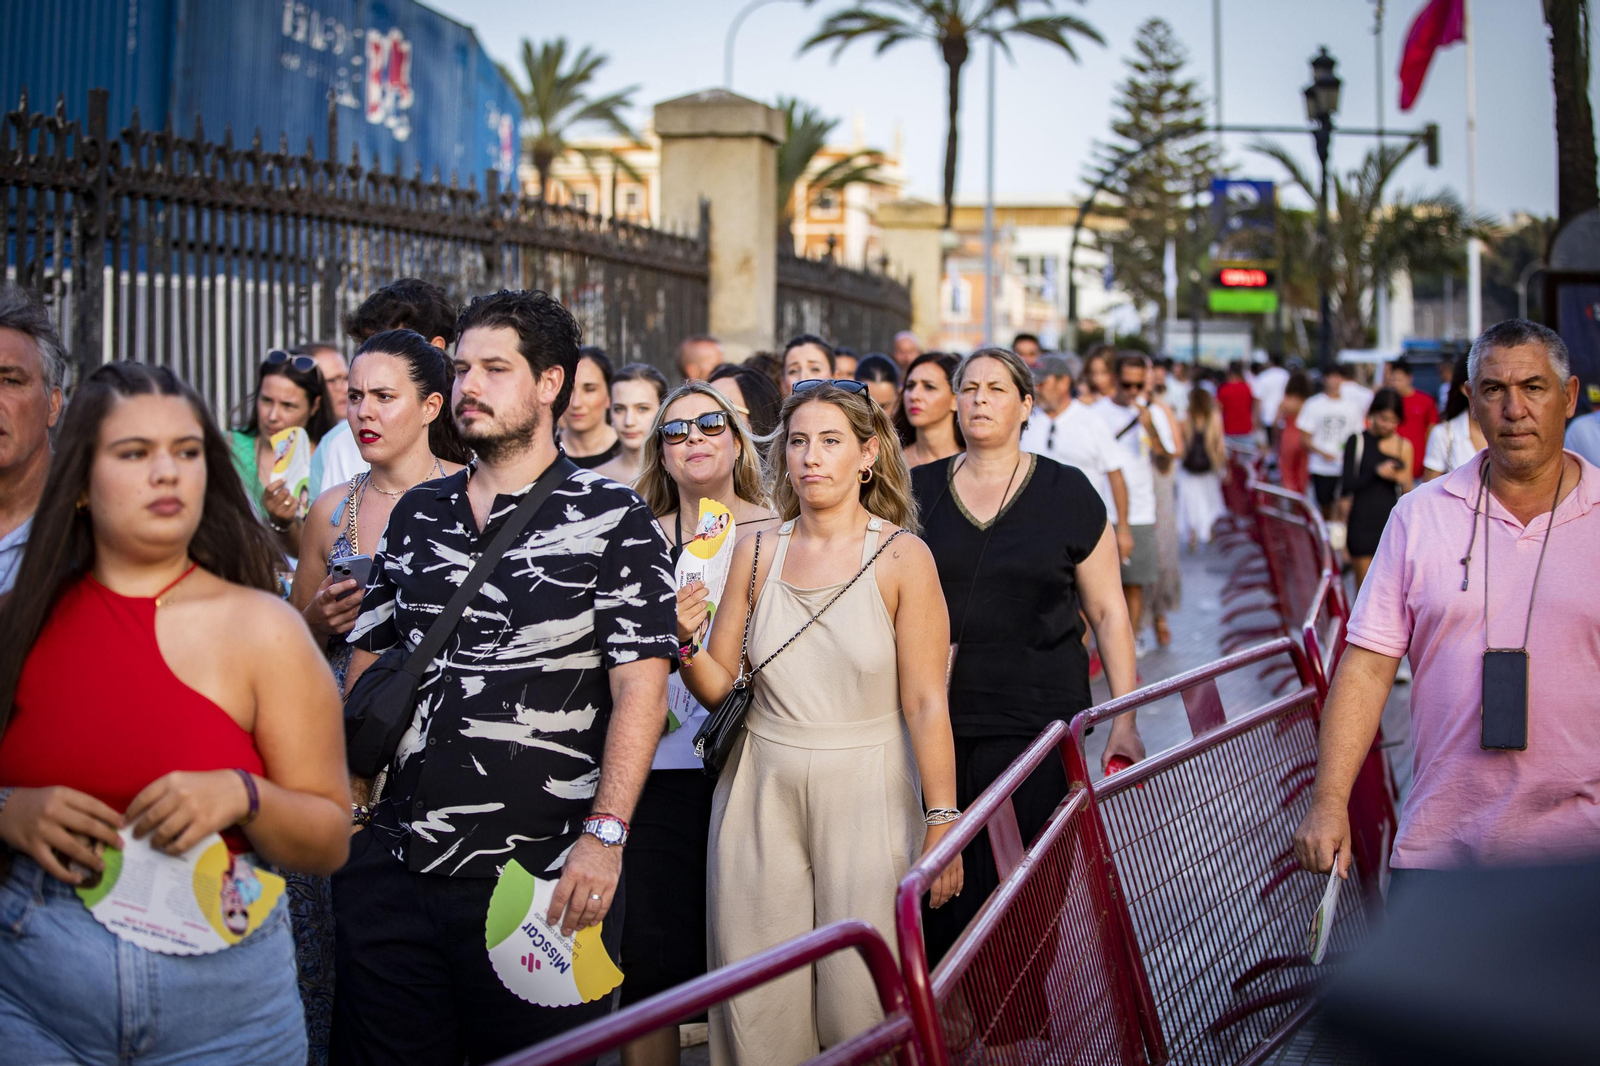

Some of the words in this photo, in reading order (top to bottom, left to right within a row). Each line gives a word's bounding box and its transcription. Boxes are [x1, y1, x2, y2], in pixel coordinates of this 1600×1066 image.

[553, 932, 565, 944] para
[521, 922, 571, 974] MissCar
[563, 942, 574, 953] app
